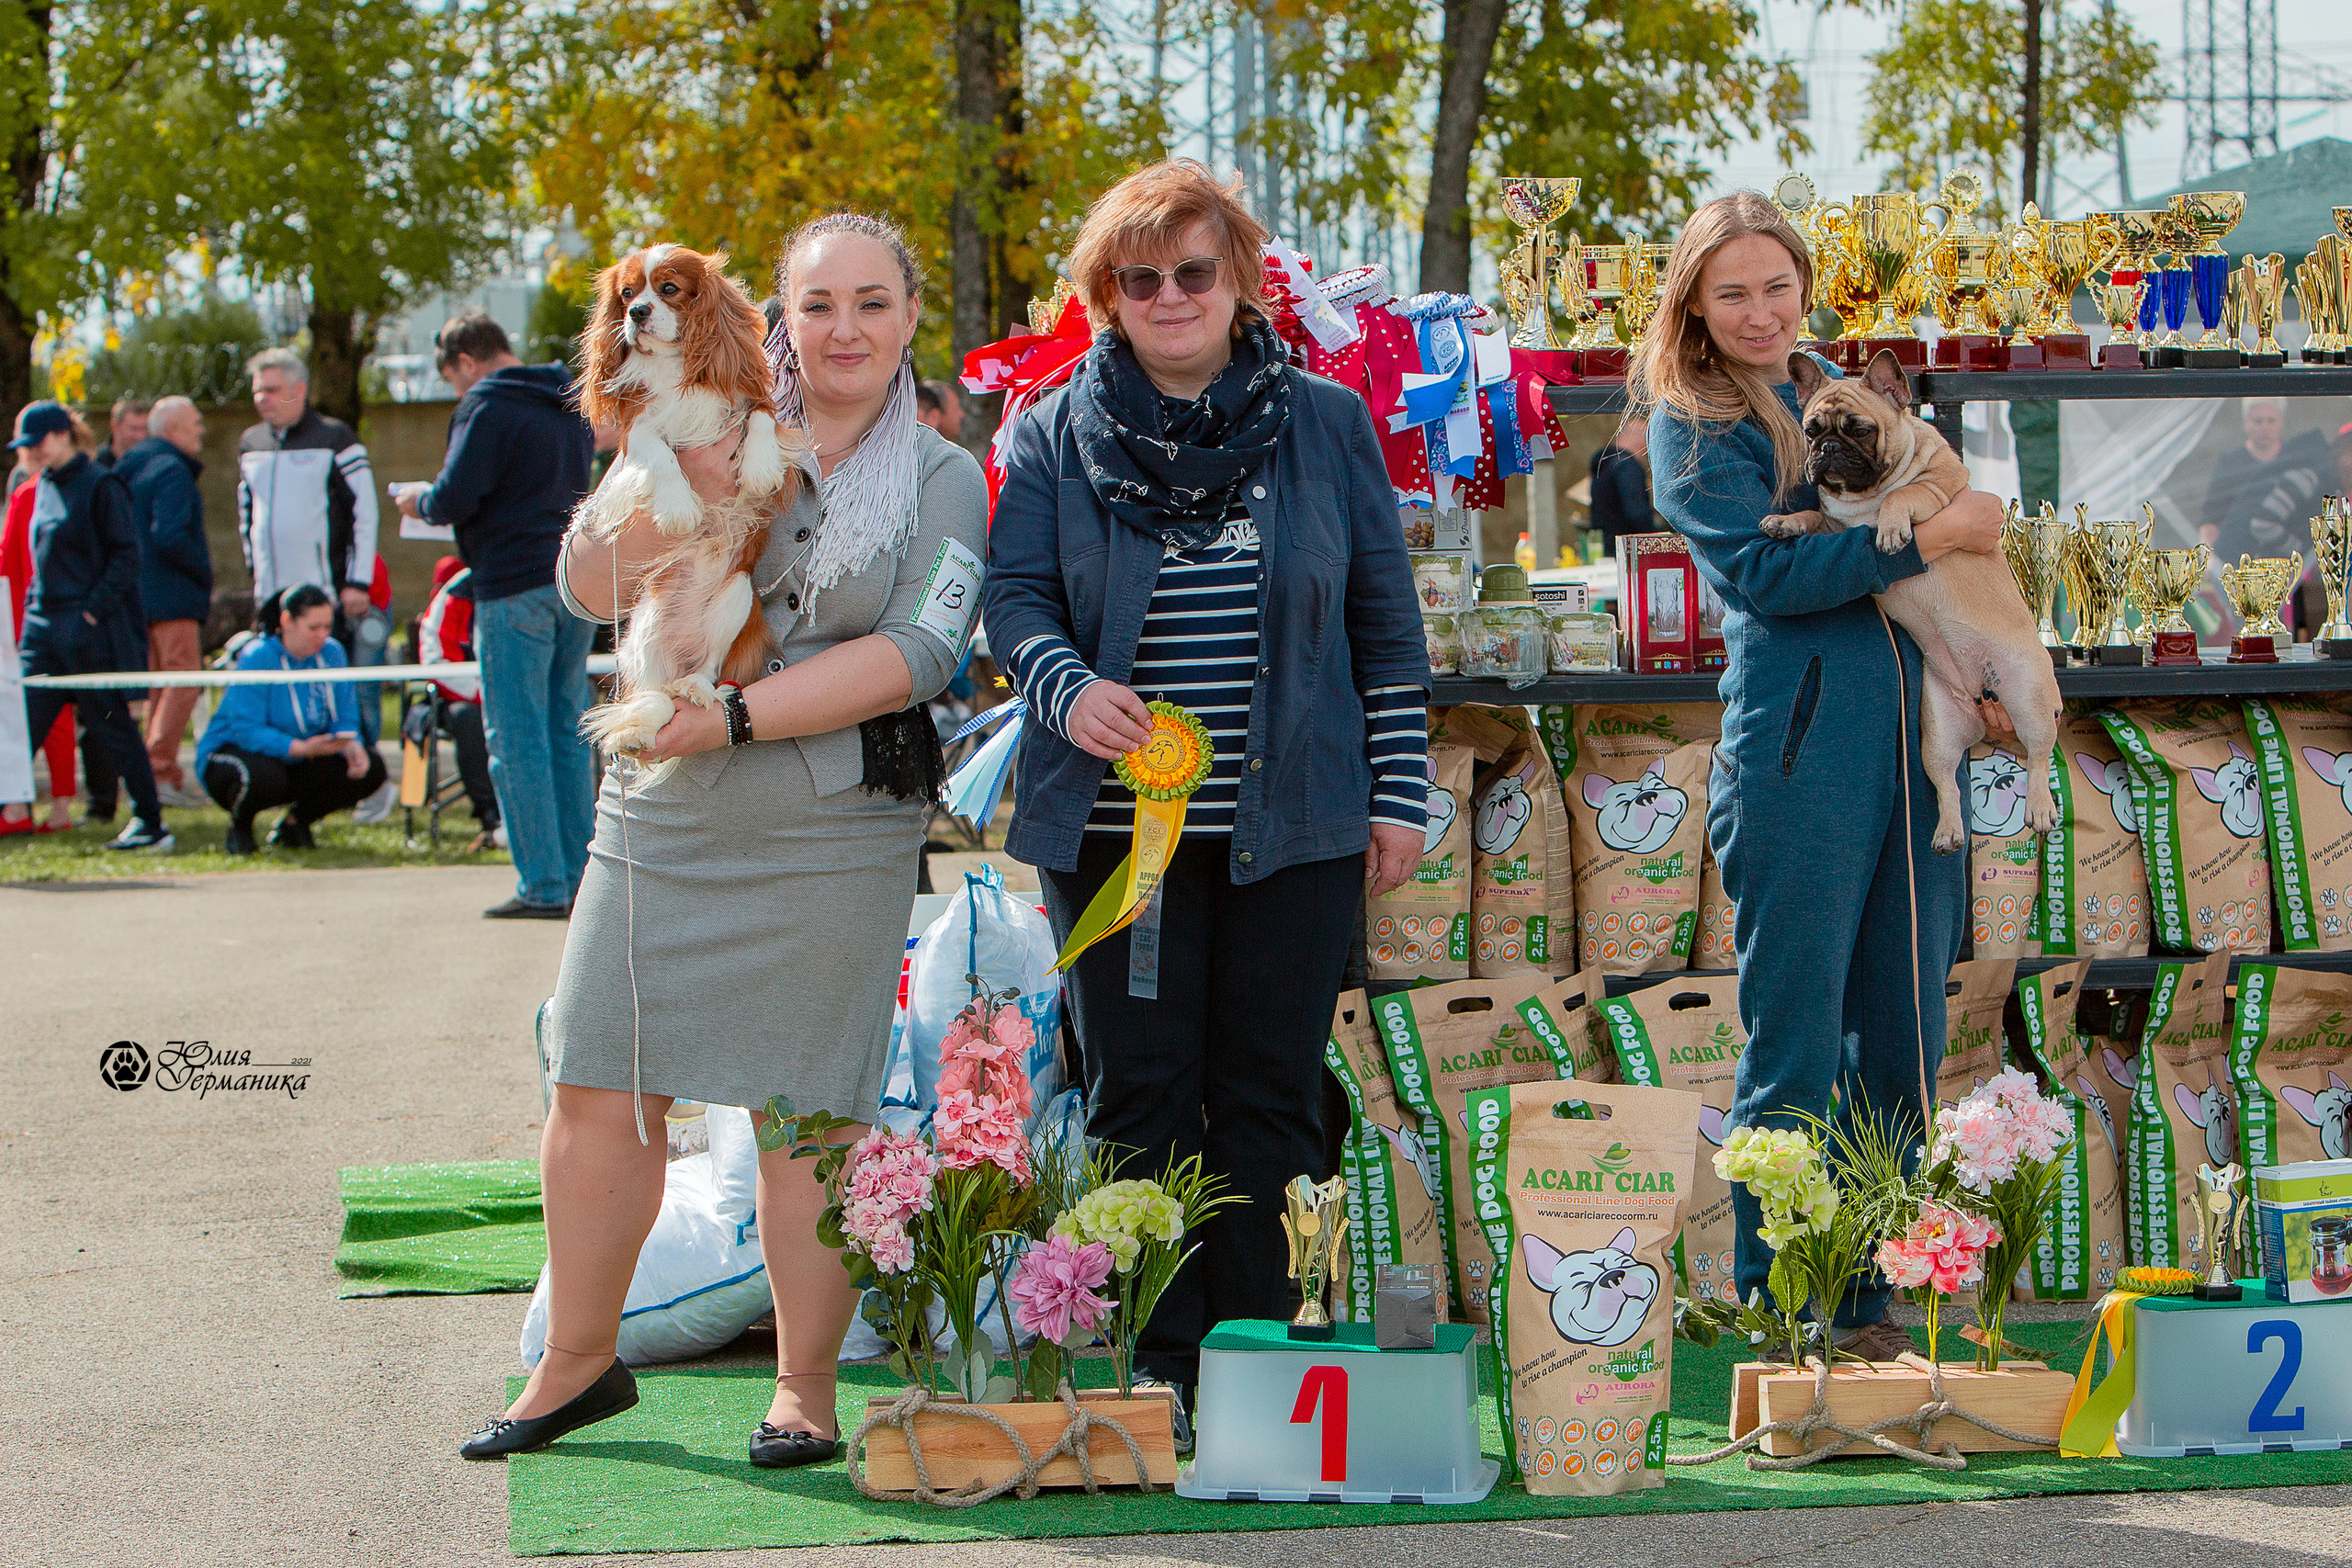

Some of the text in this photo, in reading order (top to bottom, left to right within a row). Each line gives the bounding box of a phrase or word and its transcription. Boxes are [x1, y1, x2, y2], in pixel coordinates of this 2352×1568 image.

[926, 570, 938, 585] Line
[933, 558, 943, 570] Pet
[938, 541, 950, 558] Food
[949, 554, 970, 570] ACARI
[935, 578, 966, 610] 13
[1535, 592, 1566, 600] satoshi
[1585, 737, 1637, 747] Professional
[2120, 727, 2154, 764] DOG
[1991, 848, 2028, 862] organic
[2005, 838, 2037, 850] natural
[2078, 839, 2122, 867] We know how
[2311, 852, 2324, 862] We
[2323, 838, 2341, 855] know
[1492, 858, 1526, 870] natural
[1640, 856, 1681, 867] natural
[2091, 864, 2099, 874] to
[2099, 858, 2112, 872] rise
[2188, 845, 2233, 881] We know how
[2270, 786, 2310, 941] PROFESSIONAL
[2324, 858, 2331, 866] to
[2331, 849, 2345, 862] rise
[1409, 867, 1465, 881] ganic food
[1482, 868, 1544, 882] organic food
[1624, 865, 1694, 879] organic food
[2200, 874, 2209, 885] to
[2209, 868, 2222, 880] rise
[2148, 973, 2175, 1027] FOOD
[2243, 973, 2265, 1032] FOOD
[1607, 1004, 1642, 1051] FOOD
[2025, 986, 2041, 1047] FOOD
[1385, 1001, 1415, 1057] FOOD
[1527, 1007, 1568, 1060] FOOD
[2160, 1032, 2190, 1046] ACA
[2269, 1032, 2352, 1052] ACARI CIA
[1326, 1041, 1342, 1068] FO
[1440, 1049, 1504, 1074] ACARI
[1668, 1044, 1726, 1065] ACARI
[2235, 1035, 2259, 1079] DOG
[1398, 1058, 1426, 1104] DOG
[1441, 1070, 1498, 1085] Professional
[1500, 1066, 1520, 1077] Line
[1522, 1066, 1539, 1077] Dog
[1670, 1062, 1736, 1076] Professional Lin
[1687, 1074, 1736, 1086] www.acariciar
[1476, 1098, 1499, 1163] FOOD
[1521, 1167, 1676, 1193] ACARI CIAR
[1476, 1164, 1502, 1221] DOG
[1520, 1191, 1675, 1208] Professional Line Dog Food
[2128, 1127, 2144, 1267] ROFESSIONAL
[2146, 1128, 2169, 1269] ROFESSIONAL
[1365, 1162, 1393, 1265] ESSIONAL
[1538, 1209, 1657, 1221] www.acariciarecocorm.ru
[1687, 1200, 1721, 1224] We know
[1701, 1221, 1708, 1230] to
[1709, 1213, 1722, 1225] rise
[1344, 1163, 1371, 1323] PROFESSIONAL
[1521, 1357, 1541, 1376] know
[1541, 1348, 1557, 1365] how
[1608, 1347, 1652, 1360] natural
[1521, 1377, 1528, 1389] to
[1527, 1370, 1542, 1385] rise
[1547, 1348, 1589, 1375] champion
[1588, 1358, 1666, 1377] organic food
[2247, 1319, 2305, 1432] 2
[1605, 1382, 1656, 1391] AURORA
[1289, 1365, 1349, 1482] 1
